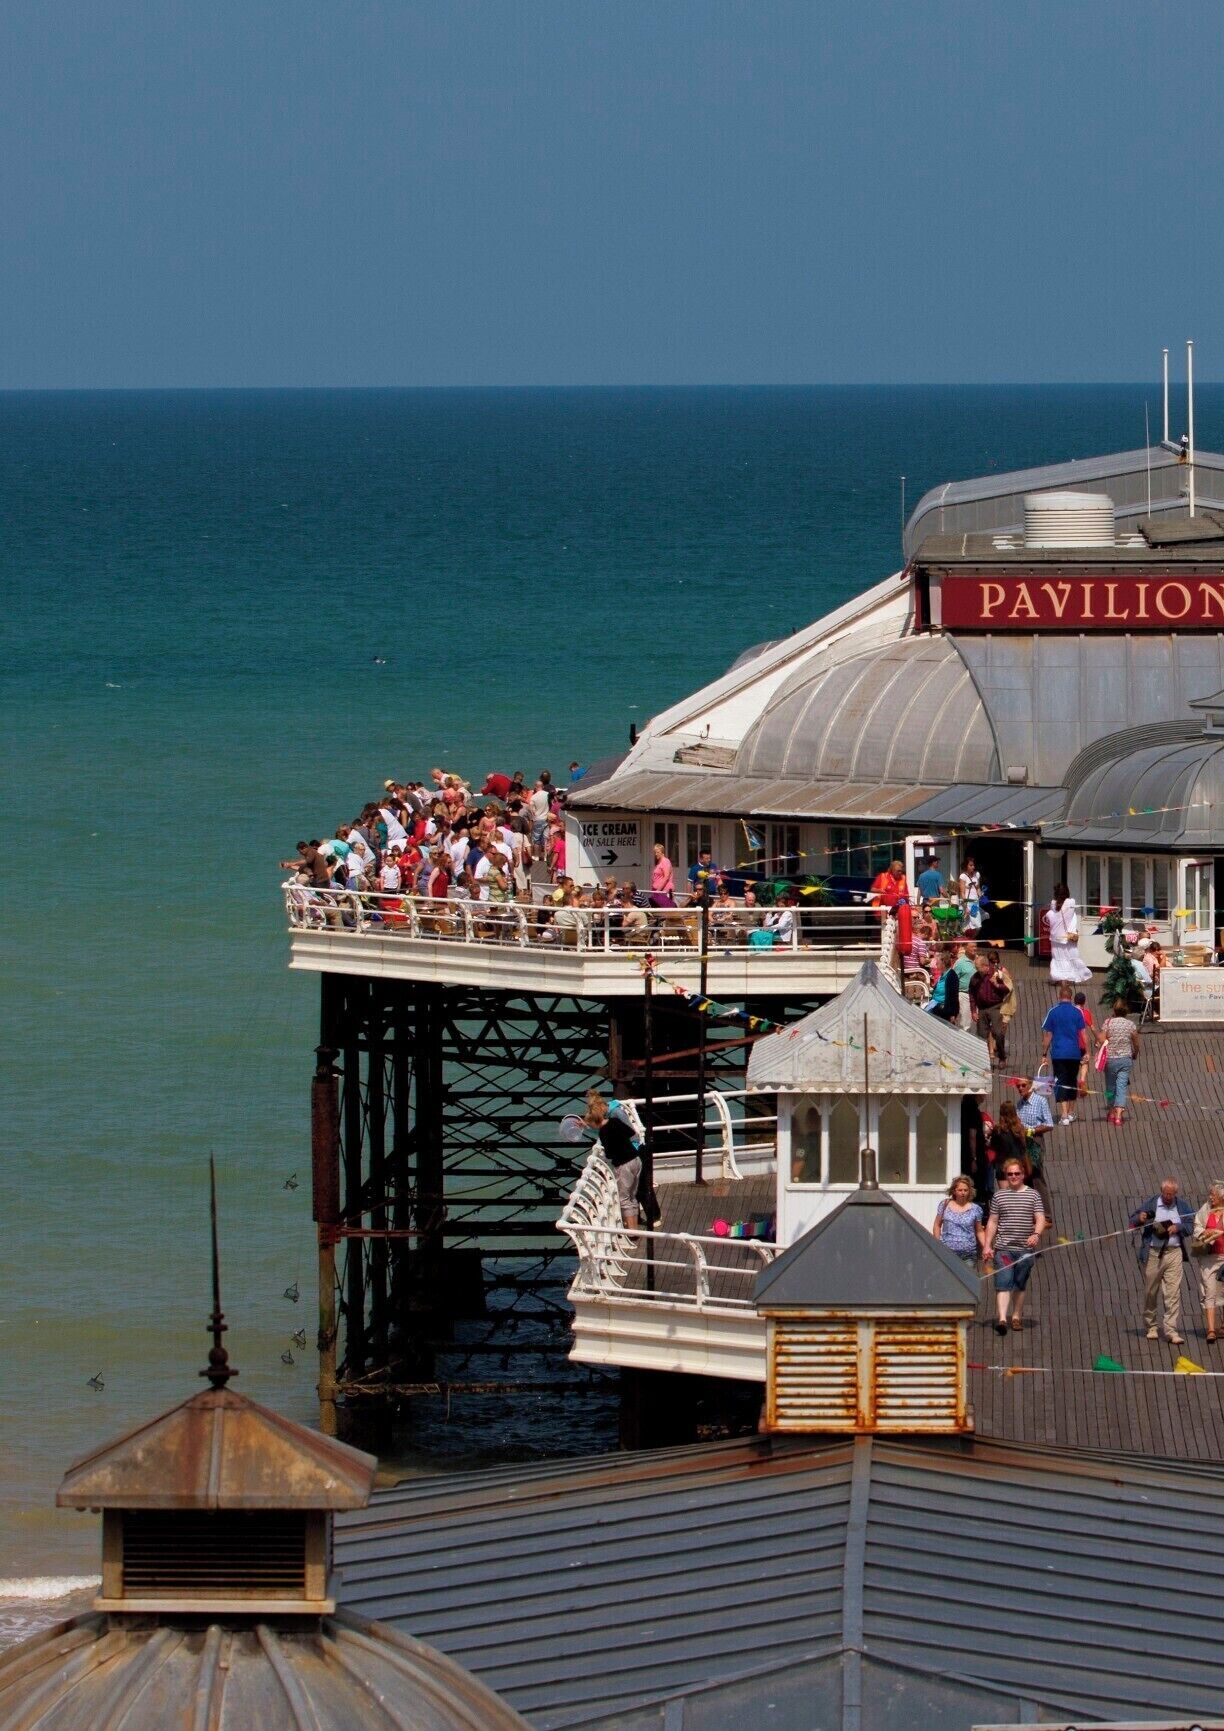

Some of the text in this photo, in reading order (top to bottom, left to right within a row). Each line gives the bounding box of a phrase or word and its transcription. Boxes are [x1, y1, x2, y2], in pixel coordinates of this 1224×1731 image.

[583, 823, 637, 836] ICE CREAM
[583, 836, 637, 847] ON SALE HERE
[1181, 981, 1201, 993] the
